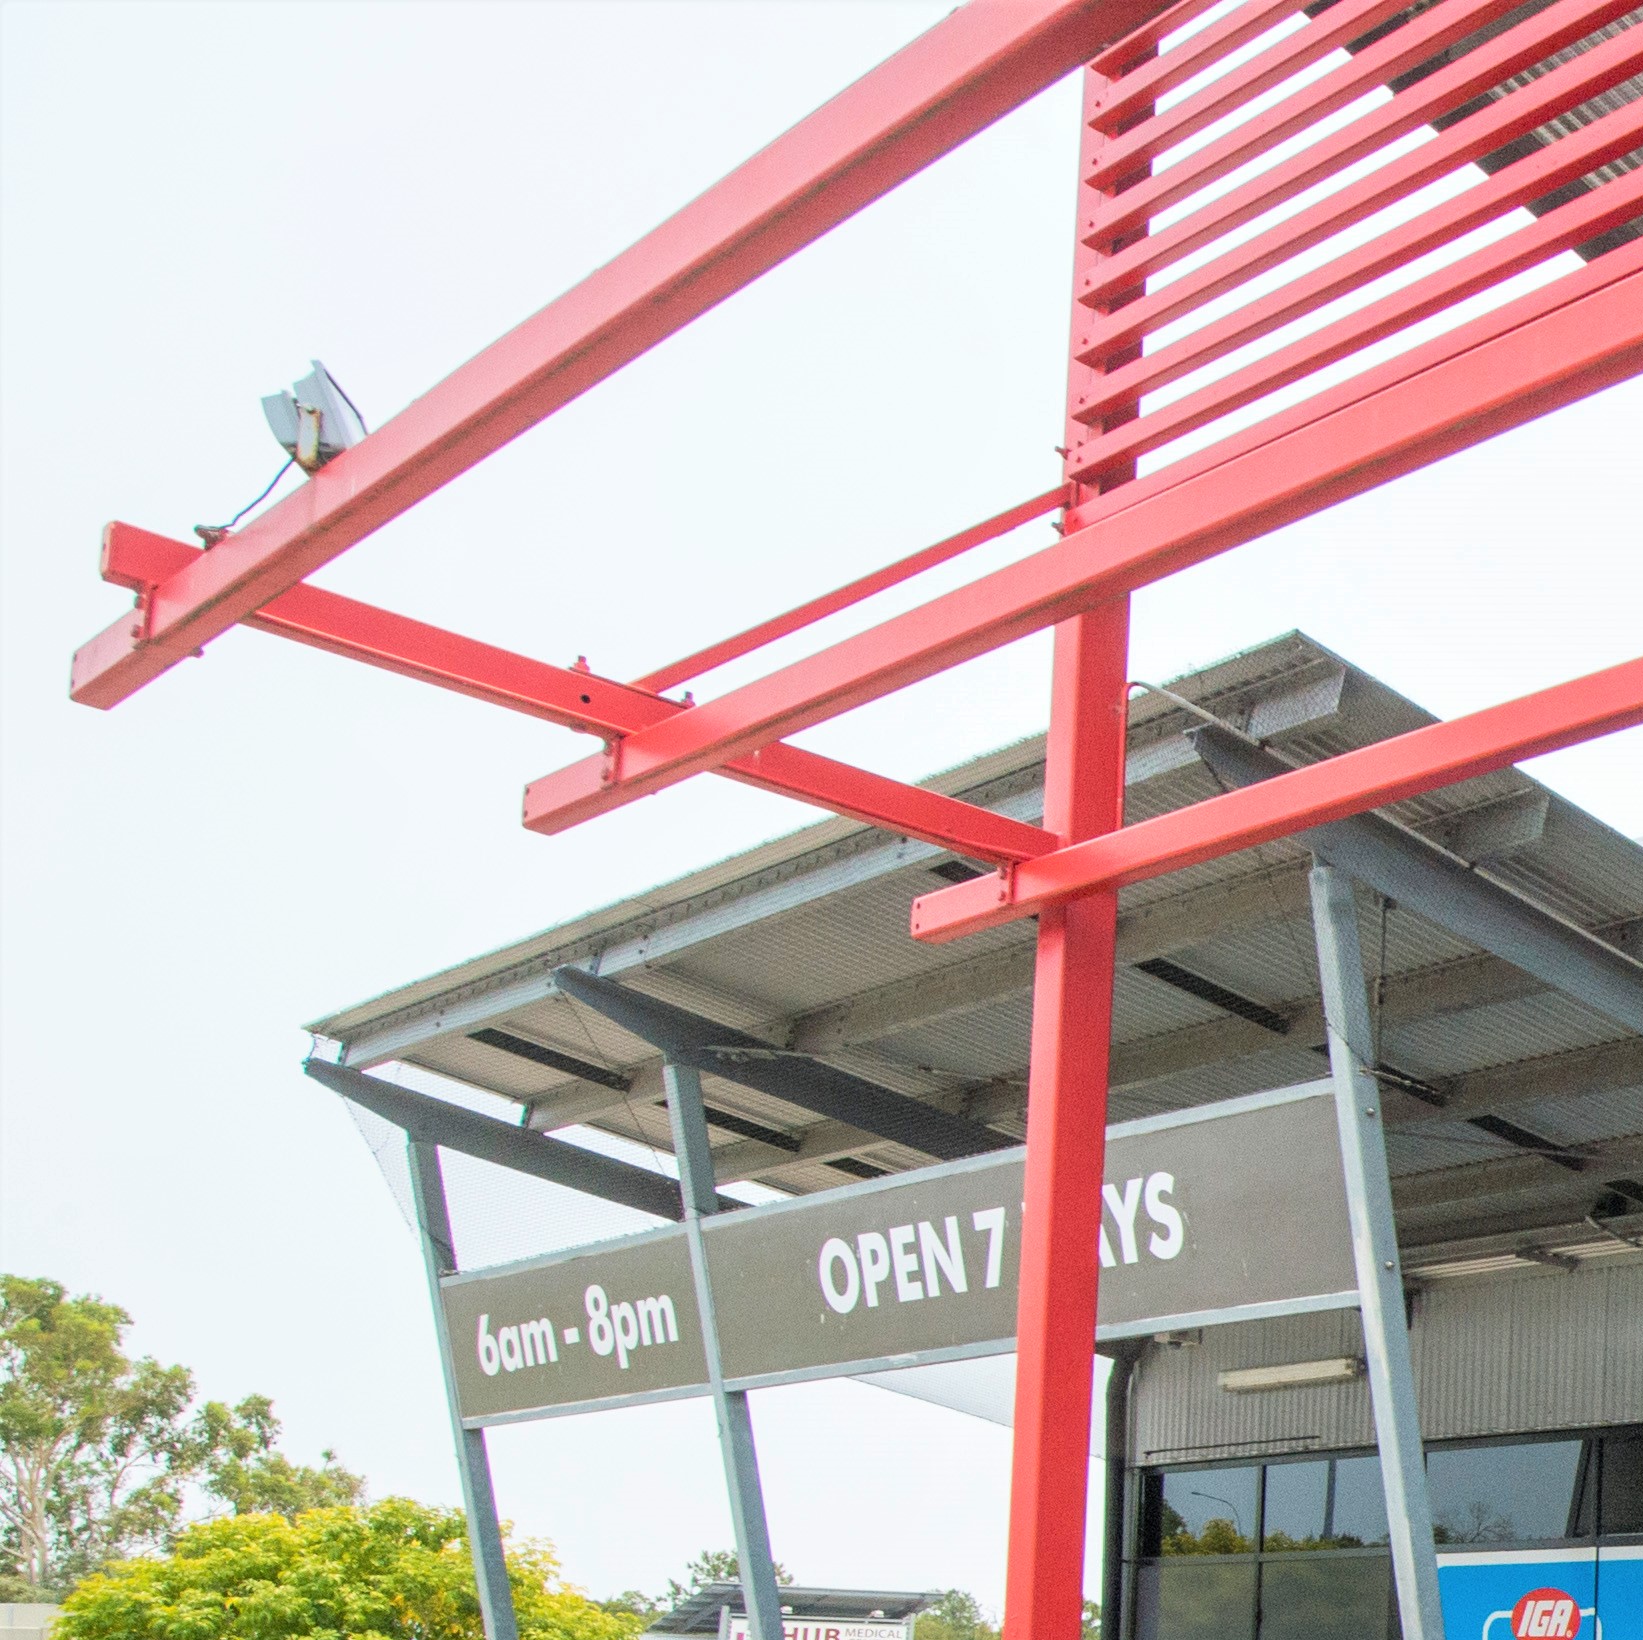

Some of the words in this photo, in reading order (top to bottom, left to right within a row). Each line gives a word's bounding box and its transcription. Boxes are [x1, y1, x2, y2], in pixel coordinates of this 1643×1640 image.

[819, 1215, 968, 1314] OPEN
[973, 1207, 1006, 1289] 7
[478, 1313, 559, 1377] 6am
[584, 1284, 679, 1370] 8pm
[844, 1628, 902, 1639] MEDICAL
[1517, 1599, 1575, 1638] IGA
